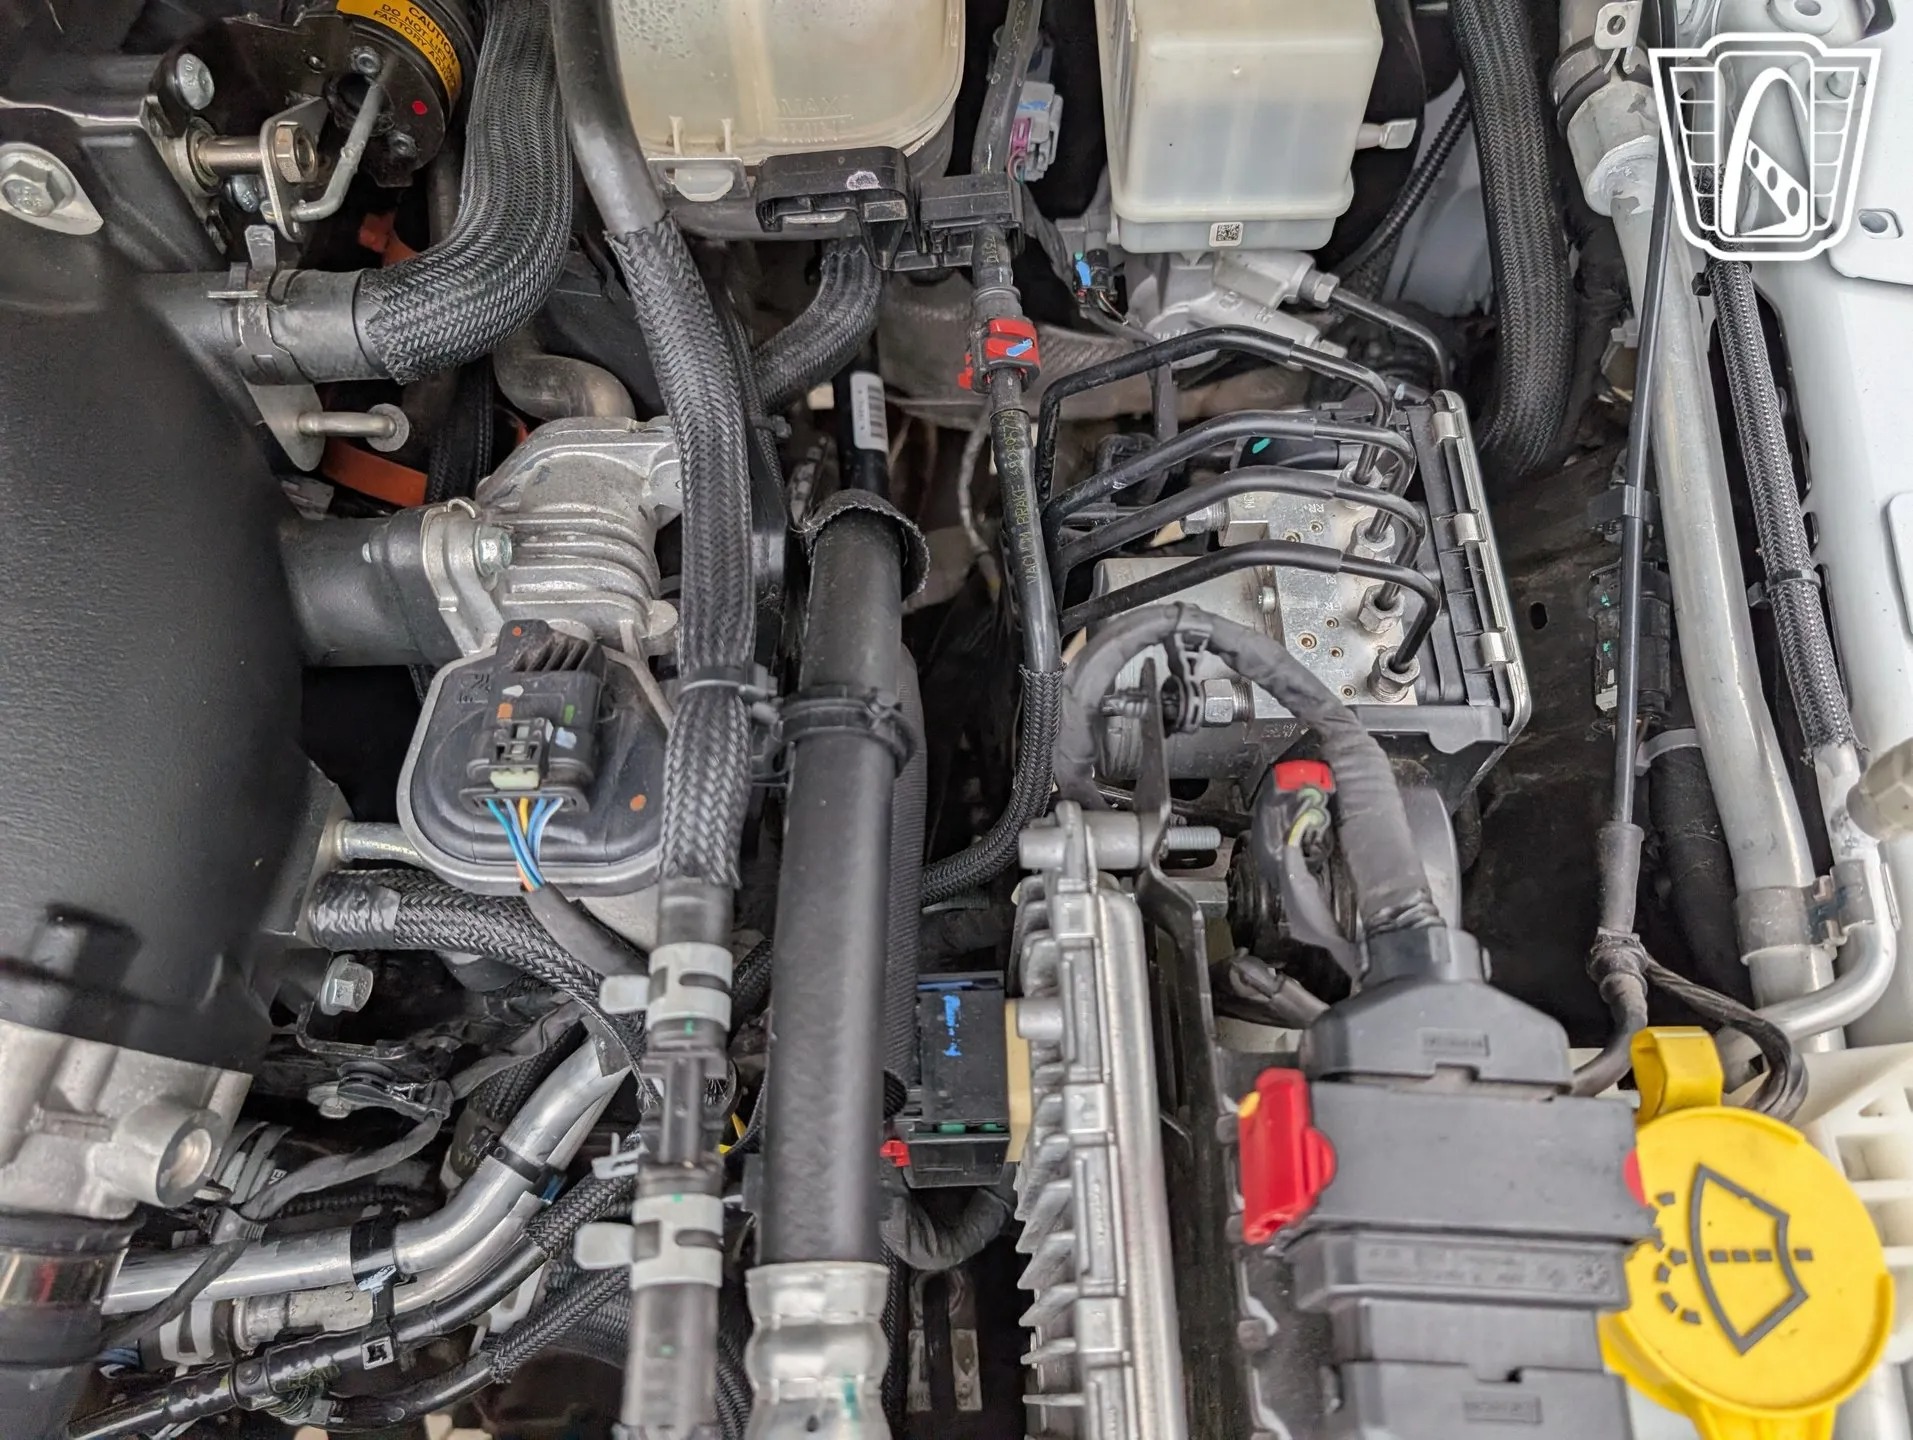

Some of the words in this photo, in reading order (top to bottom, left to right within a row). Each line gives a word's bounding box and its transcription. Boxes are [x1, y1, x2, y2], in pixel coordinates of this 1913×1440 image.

[373, 9, 428, 47] FACTORY
[381, 3, 401, 17] DO
[404, 15, 428, 37] NOT
[429, 38, 448, 61] LIFT
[408, 6, 457, 65] CAUTION
[1010, 484, 1031, 526] BRAKE
